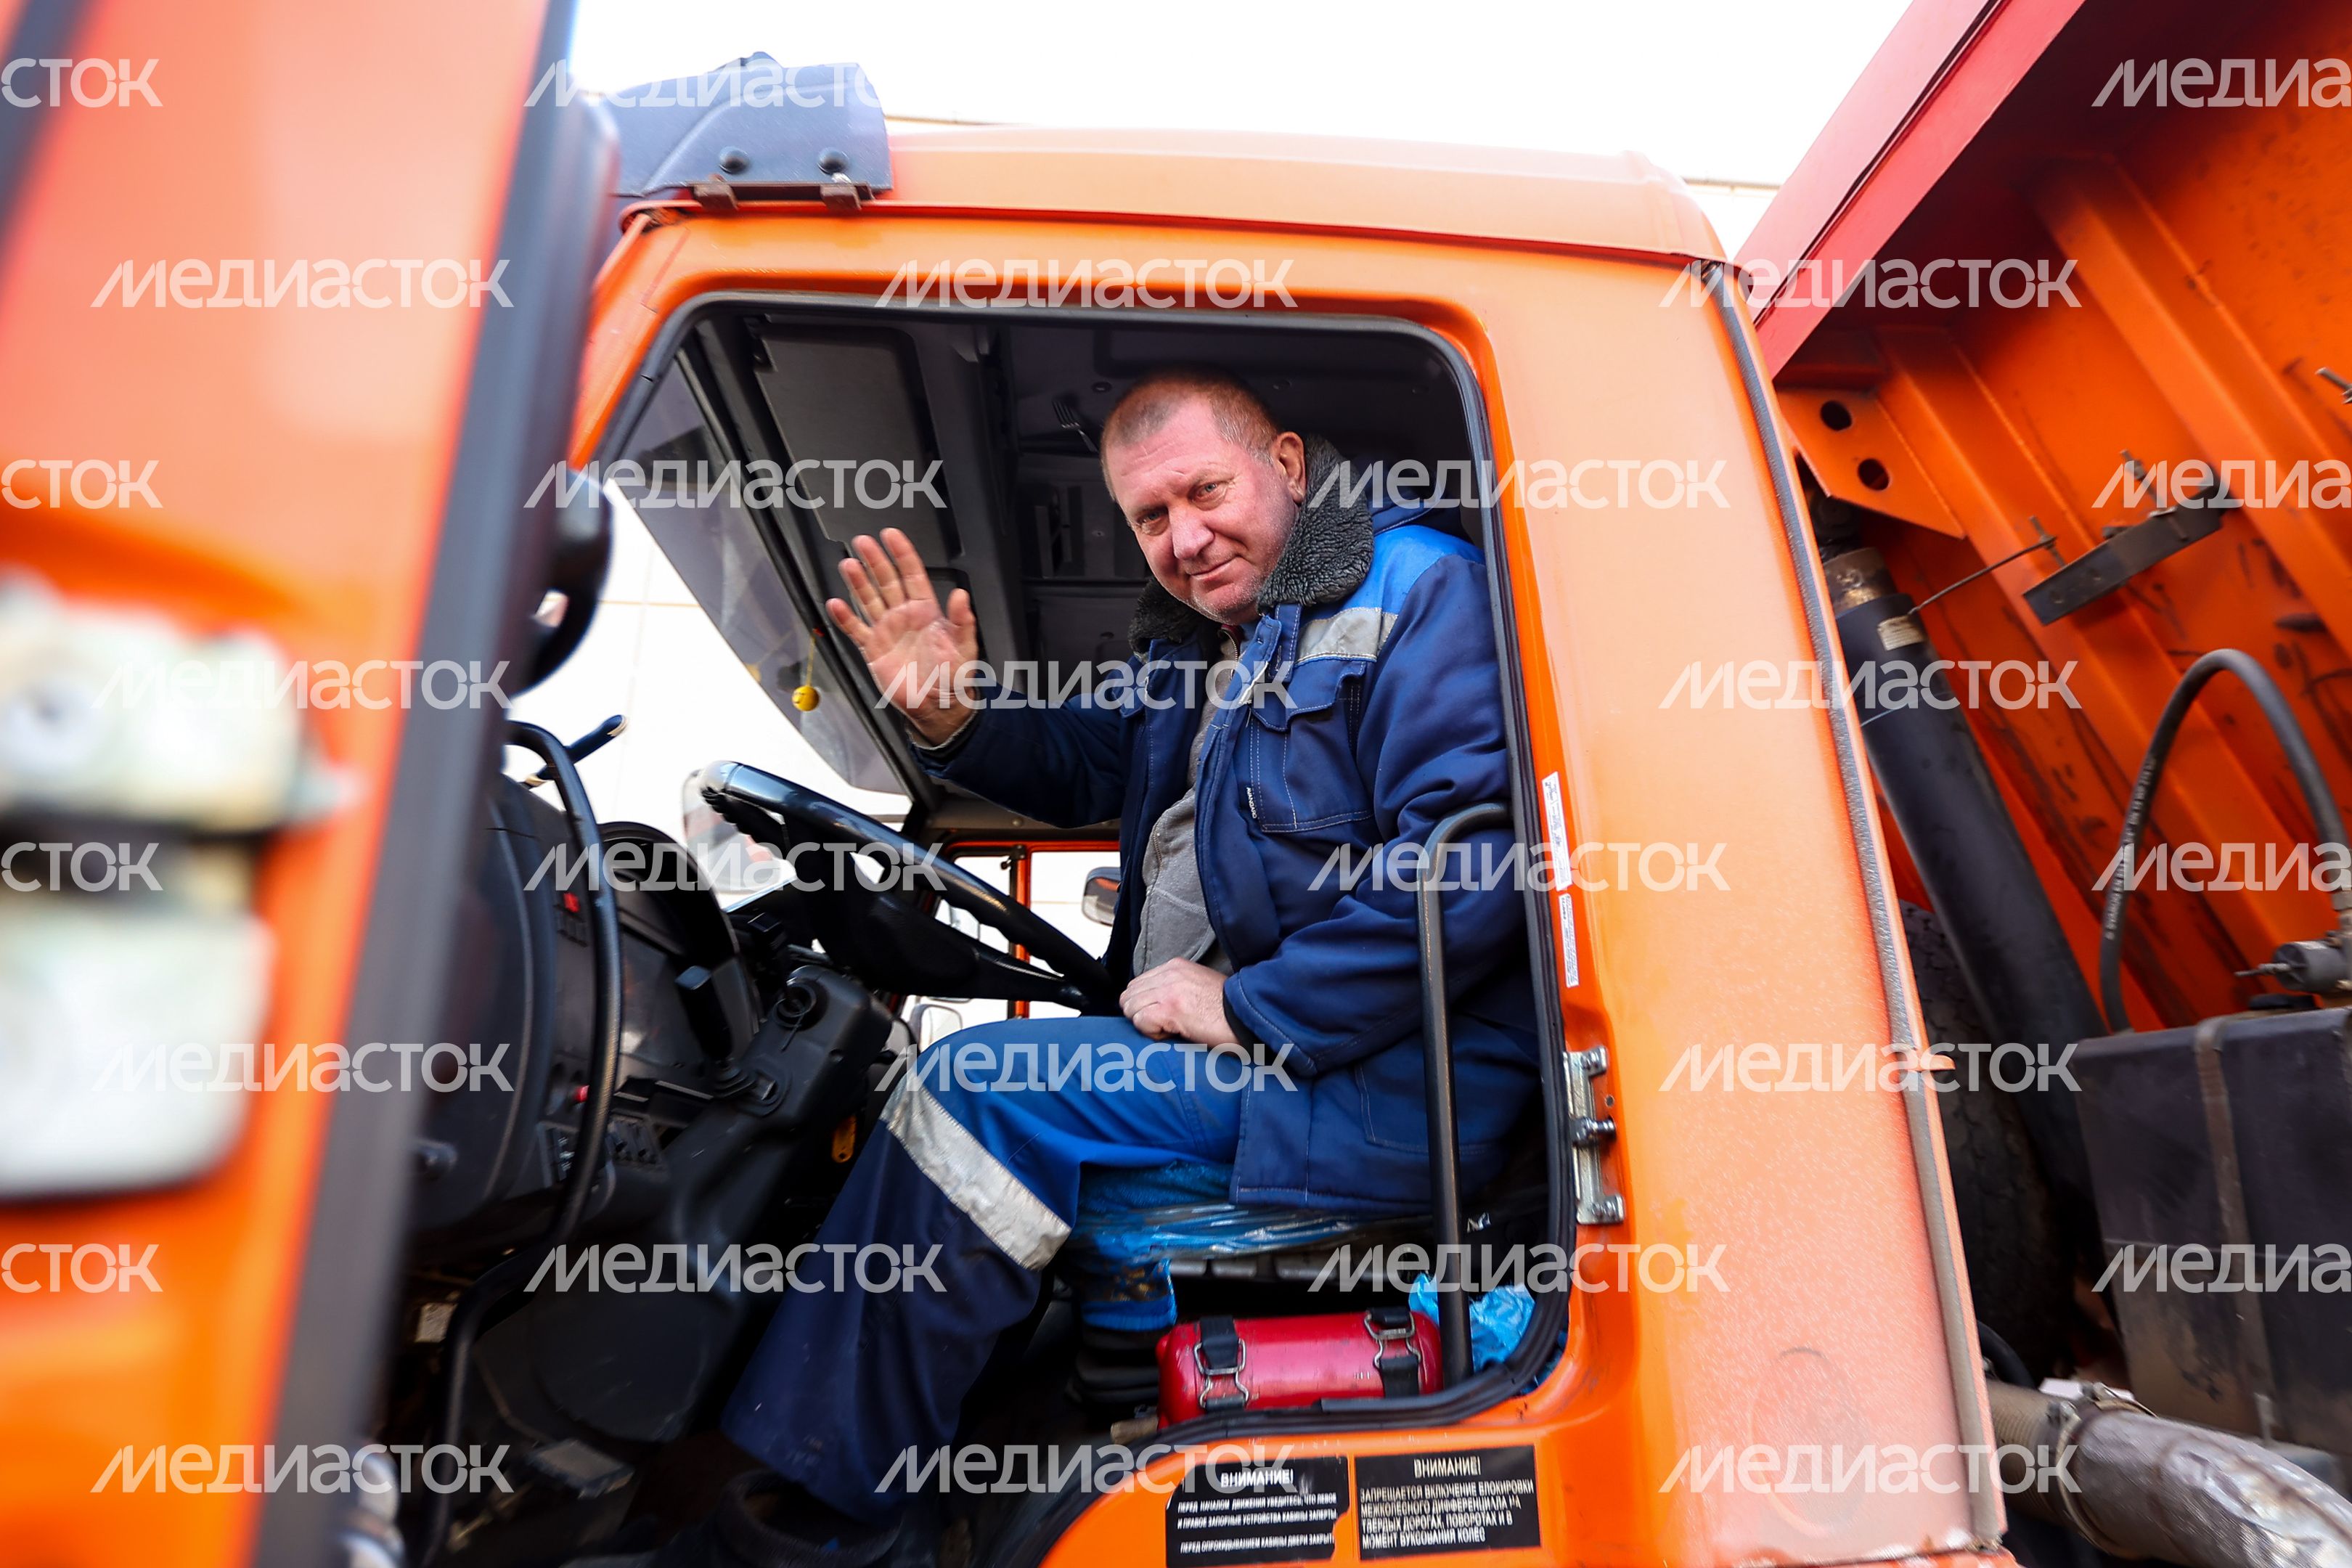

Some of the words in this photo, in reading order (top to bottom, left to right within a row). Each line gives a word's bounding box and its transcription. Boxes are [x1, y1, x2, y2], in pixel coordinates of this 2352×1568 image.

[1246, 787, 1257, 819] AVANGARD
[1413, 1456, 1481, 1478] ВНИМАНИЕ!
[1221, 1469, 1294, 1487] ВНИМАНИЕ!
[1360, 1485, 1423, 1503] ЗАПРЕЩАЕТСЯ
[1424, 1482, 1477, 1499] ВКЛЮЧЕНИЕ
[1479, 1479, 1534, 1496] БЛОКИРОВКИ
[1178, 1501, 1199, 1513] ПЕРЕД
[1200, 1499, 1230, 1511] НАЧАЛОМ
[1232, 1498, 1266, 1511] ДВИЖЕНИЯ
[1304, 1494, 1316, 1506] ЧТО
[1317, 1493, 1337, 1505] ЛЕВОЕ
[1360, 1500, 1430, 1518] МЕЖКОЛЕСНОГО
[1432, 1495, 1507, 1516] ДИФФЕРЕНЦИАЛА
[1177, 1519, 1183, 1530] И
[1183, 1517, 1206, 1529] ПРАВОЕ
[1207, 1515, 1242, 1527] ЗАПОРНЫЕ
[1243, 1511, 1281, 1525] УСТРОЙСТВА
[1282, 1510, 1307, 1523] КАБИНЫ
[1446, 1511, 1497, 1528] ПОВОРОТАХ
[1498, 1511, 1506, 1525] И
[1506, 1510, 1513, 1526] В
[1180, 1541, 1201, 1553] ПЕРЕД
[1201, 1538, 1260, 1552] ОПРОКИДЫВАНИЕМ
[1261, 1536, 1287, 1549] КАБИНЫ
[1288, 1535, 1307, 1548] ДВЕРИ
[1362, 1532, 1397, 1549] МОМЕНТ
[1400, 1528, 1456, 1547] БУКСОВАНИЯ
